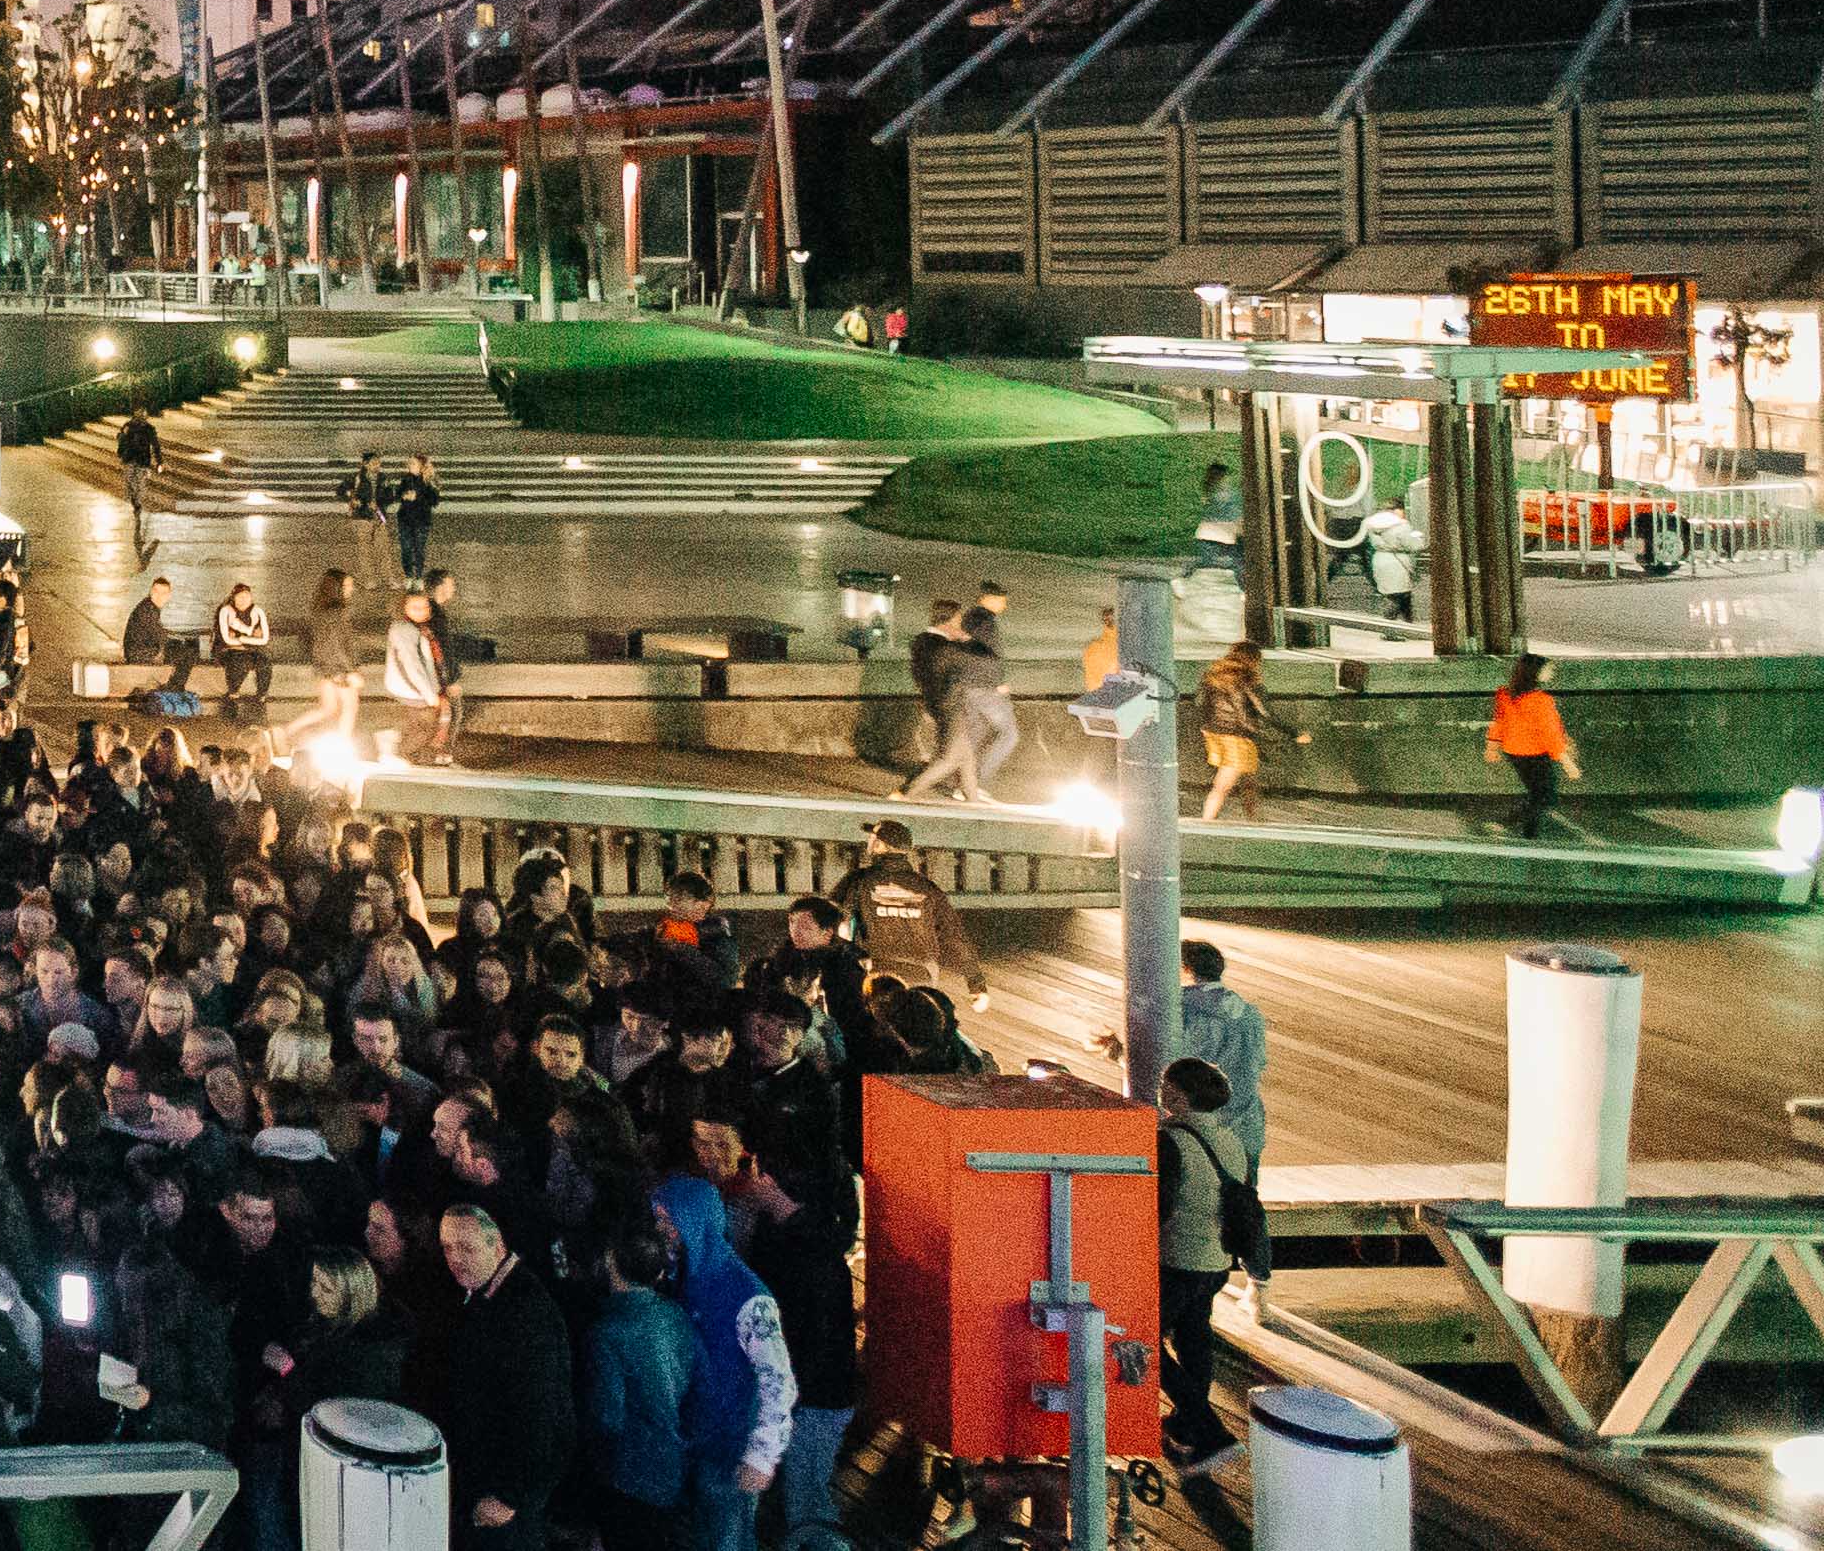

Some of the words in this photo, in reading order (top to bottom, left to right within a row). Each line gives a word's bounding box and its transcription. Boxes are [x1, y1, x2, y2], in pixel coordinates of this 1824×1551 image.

[1484, 284, 1579, 316] 26TH
[1602, 283, 1679, 316] MAY
[1570, 360, 1670, 394] JUNE
[876, 905, 922, 919] CREW
